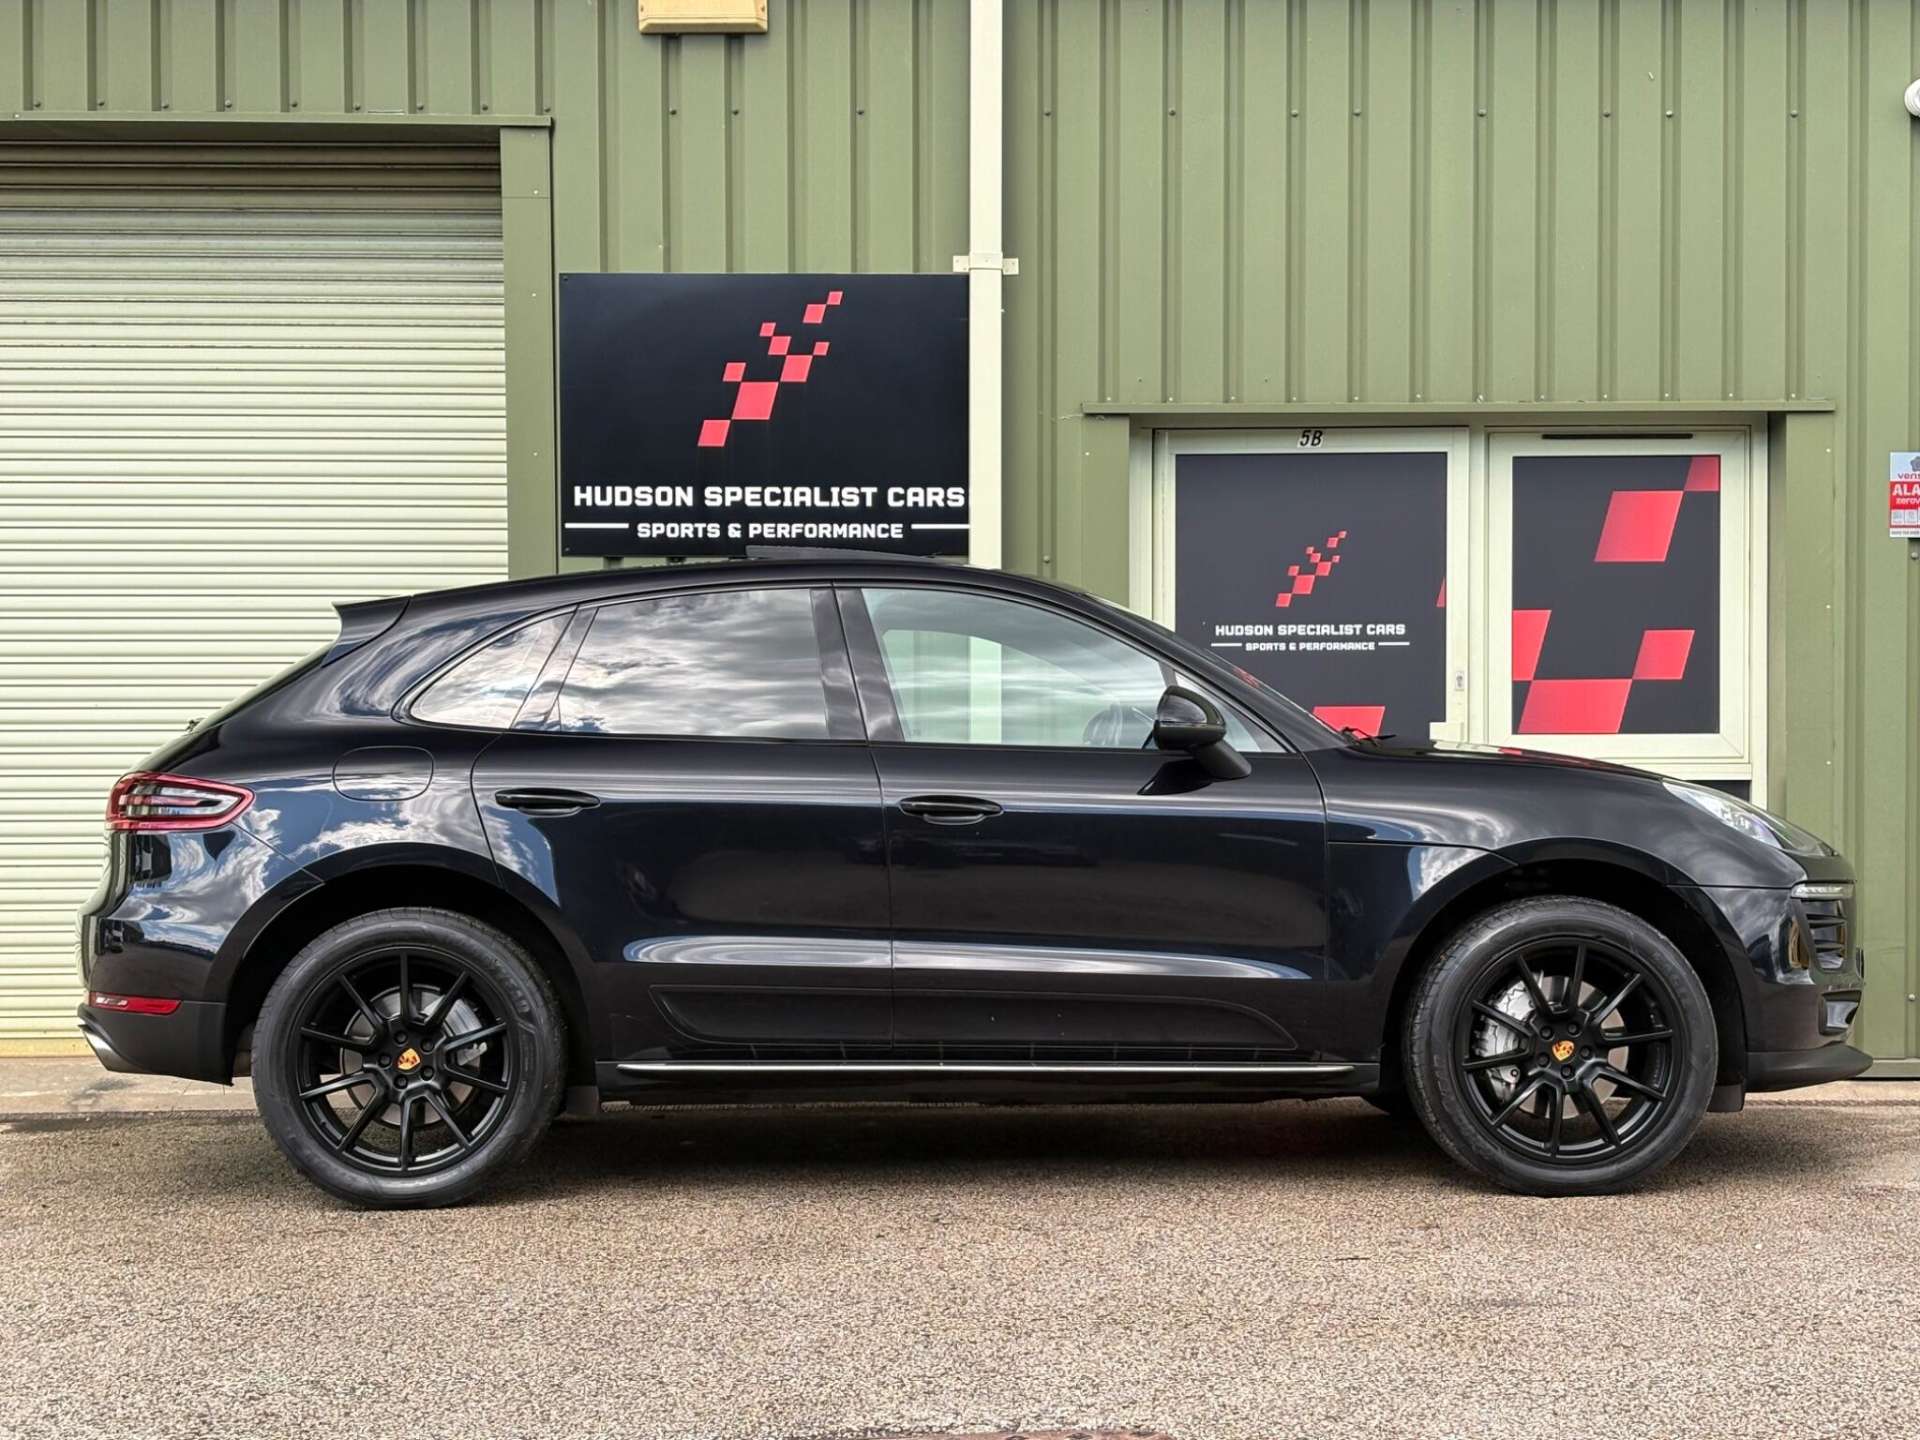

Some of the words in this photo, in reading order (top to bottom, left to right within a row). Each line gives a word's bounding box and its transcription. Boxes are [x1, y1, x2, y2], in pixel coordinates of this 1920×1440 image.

[1300, 430, 1323, 446] 5B
[573, 485, 694, 507] HUDSON
[704, 486, 878, 508] SPECIALIST
[887, 486, 966, 508] CARS
[636, 522, 721, 539] SPORTS
[727, 522, 742, 539] &
[748, 522, 904, 539] PERFORMANCE
[1215, 624, 1274, 637] HUDSON
[1277, 623, 1363, 636] SPECIALIST
[1366, 623, 1406, 636] CARS
[1245, 642, 1287, 652] SPORTS
[1288, 642, 1297, 651] &
[1298, 641, 1376, 651] PERFORMANCE
